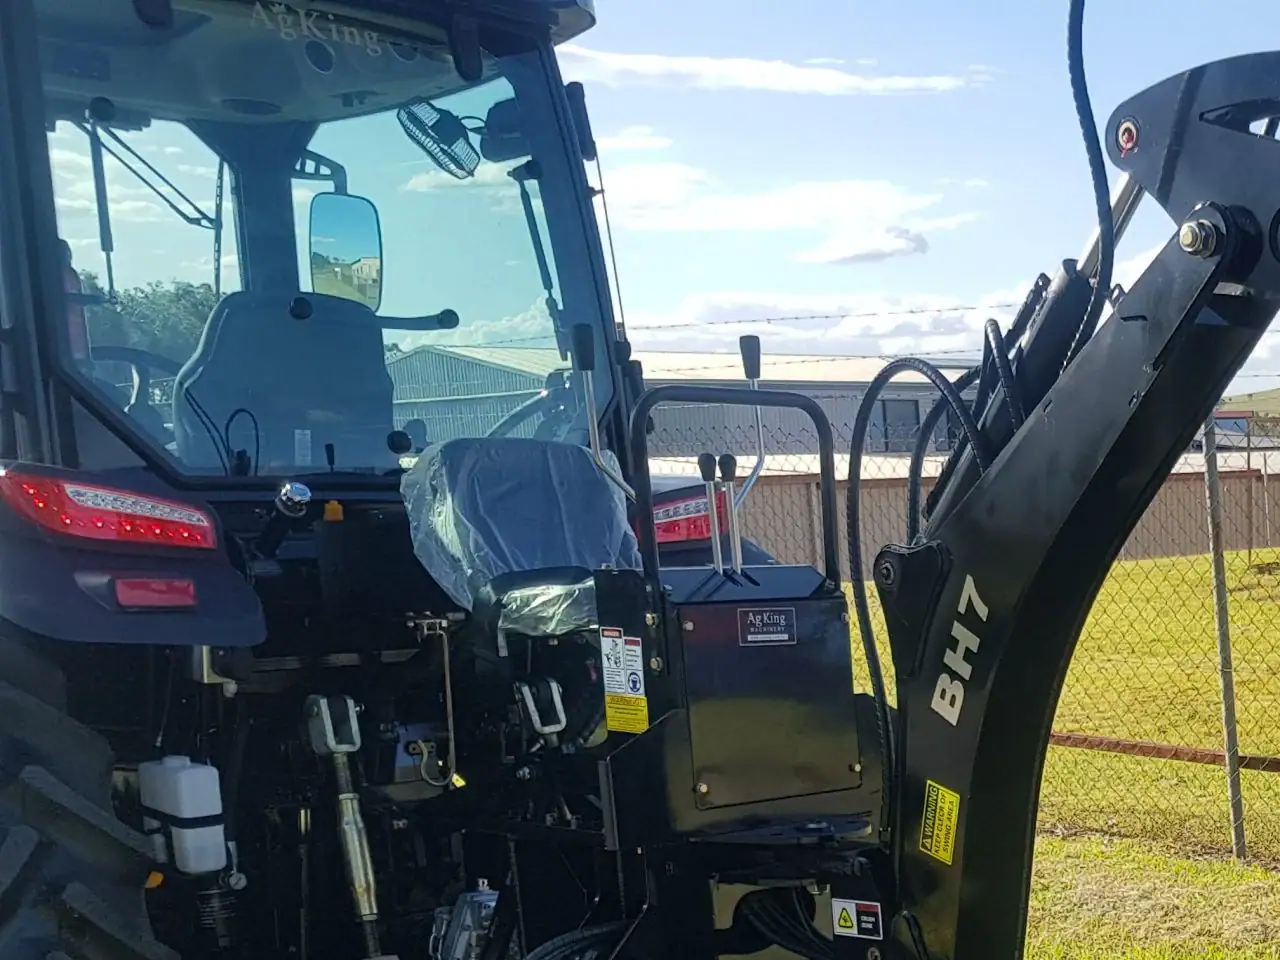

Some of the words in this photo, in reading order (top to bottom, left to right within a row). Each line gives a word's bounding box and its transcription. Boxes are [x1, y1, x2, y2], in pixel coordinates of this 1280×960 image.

[250, 1, 382, 57] AgKing
[931, 574, 989, 727] BH7
[924, 786, 938, 836] WARNING
[934, 833, 942, 854] KEEP
[943, 824, 952, 854] SWING
